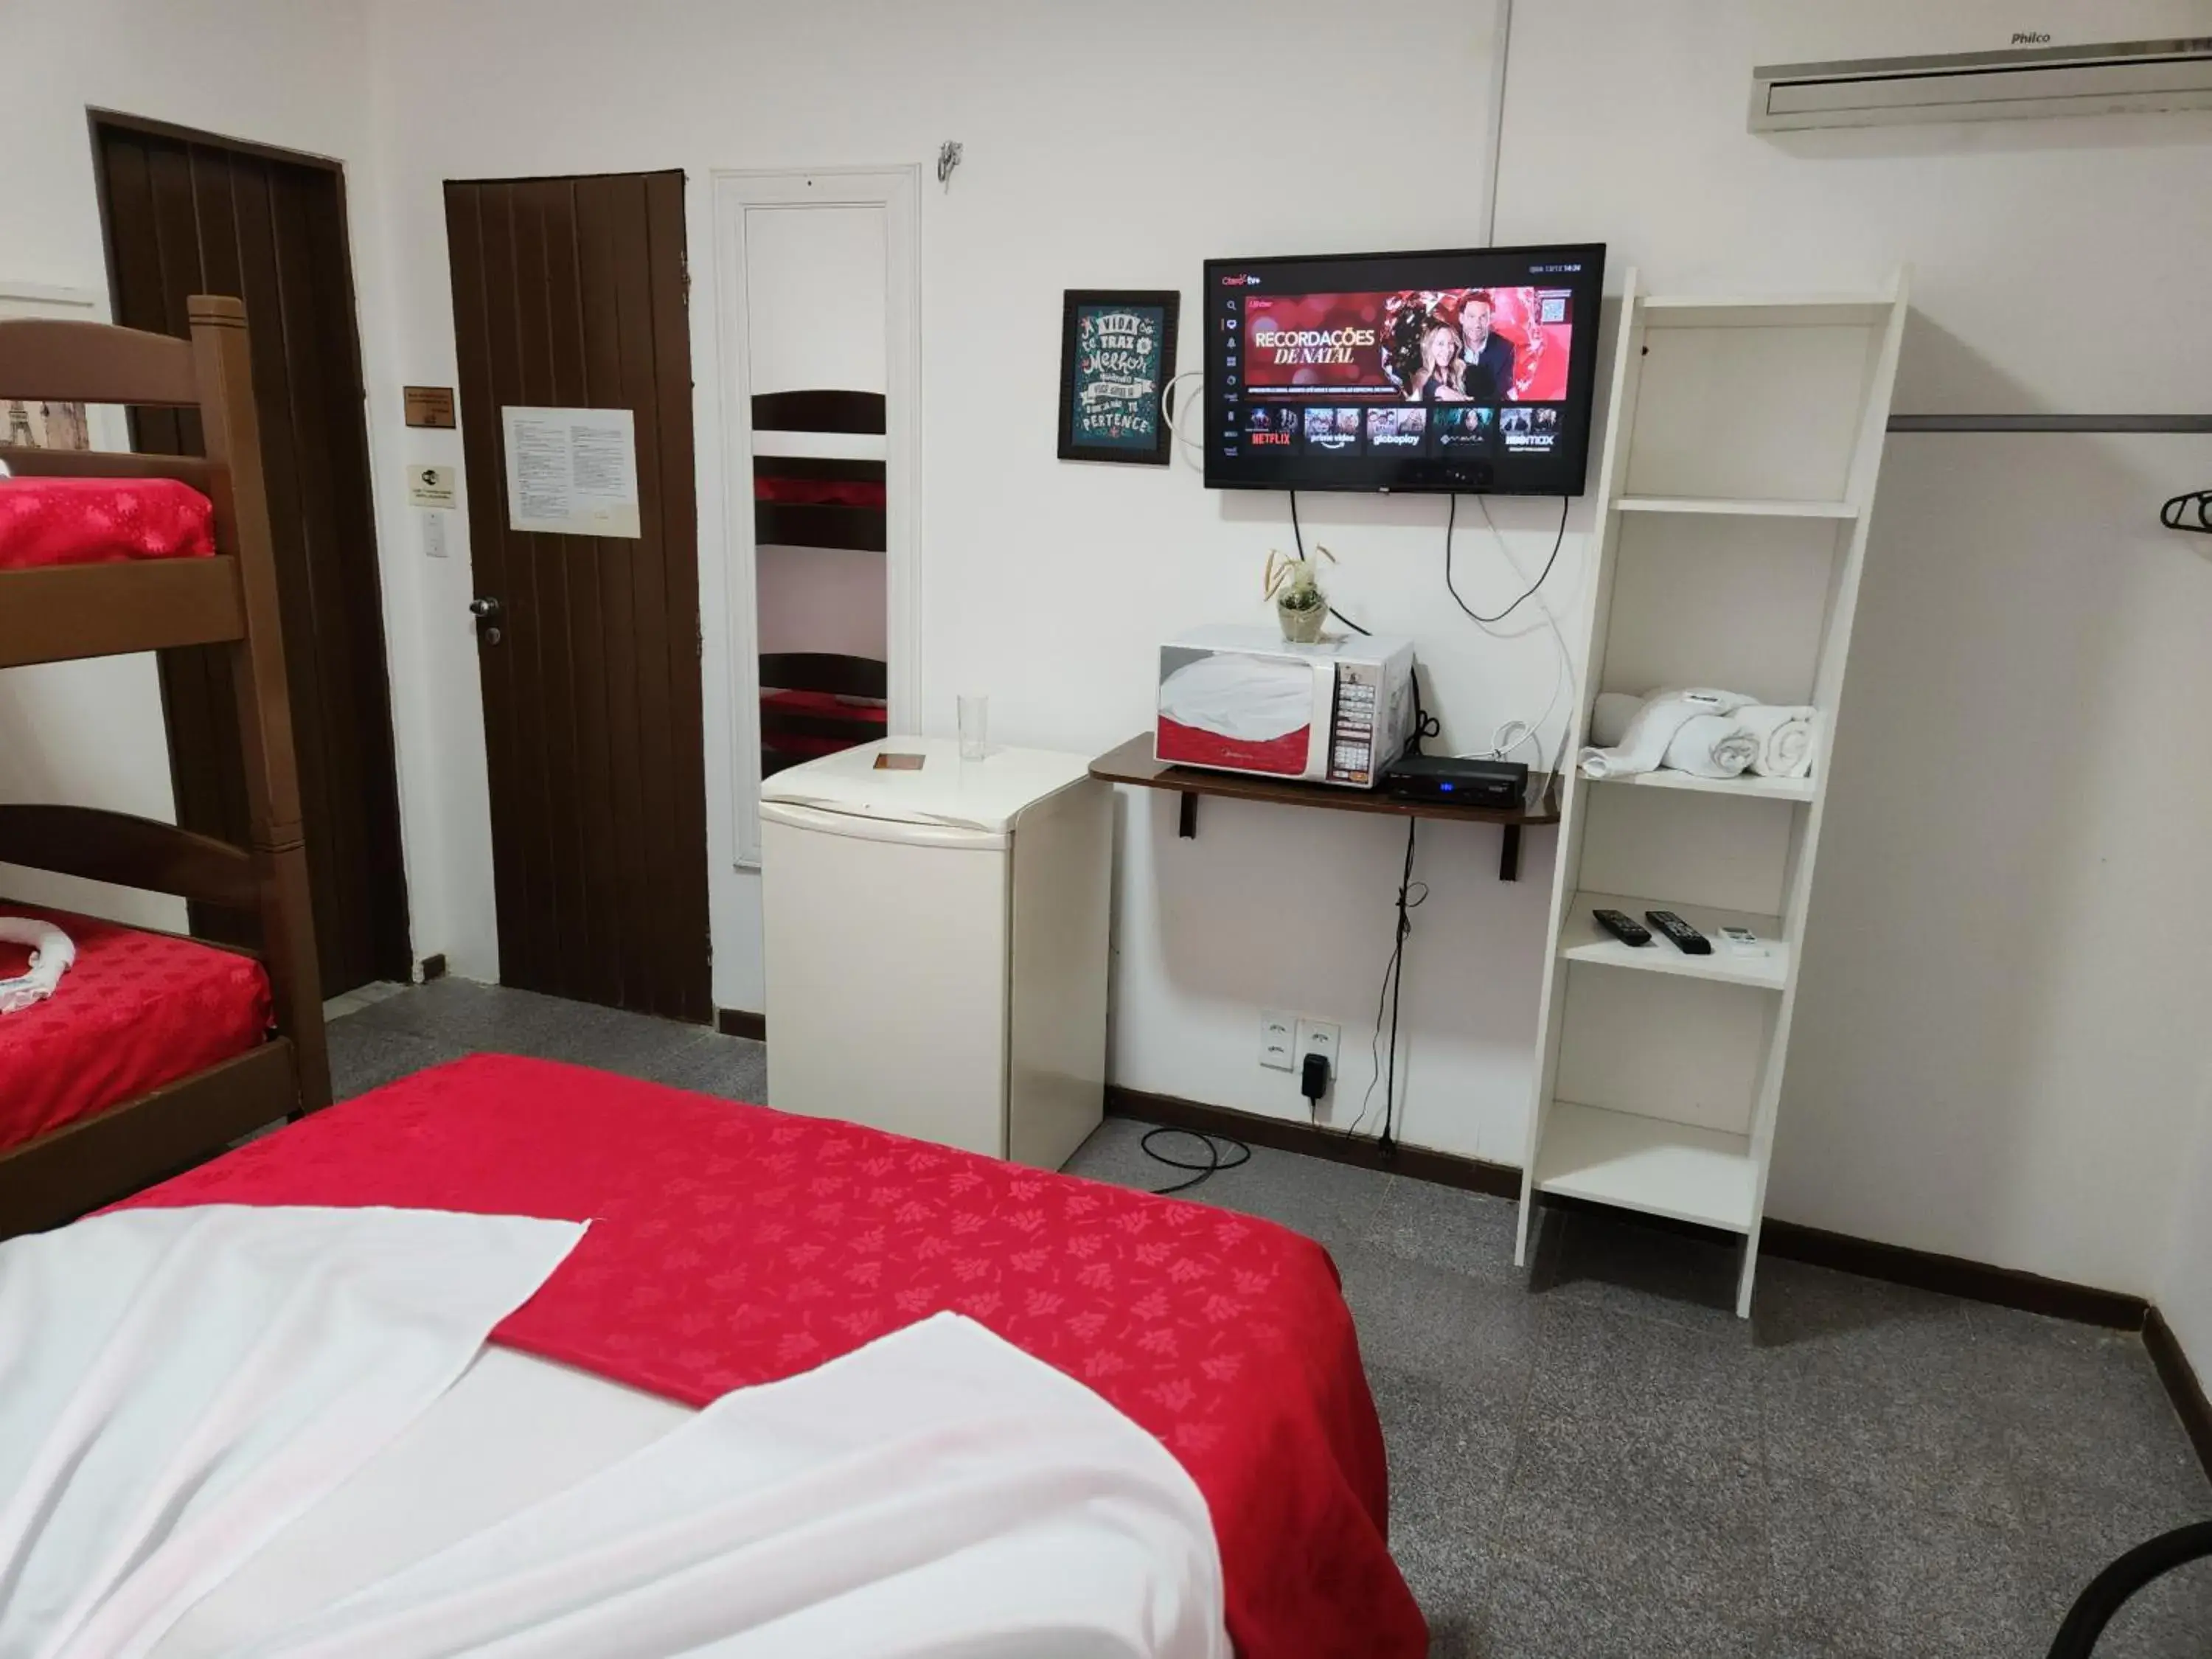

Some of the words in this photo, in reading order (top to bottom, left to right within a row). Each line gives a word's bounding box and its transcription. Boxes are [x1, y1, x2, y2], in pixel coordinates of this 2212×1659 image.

[2011, 32, 2051, 44] Philco
[1103, 316, 1134, 332] VIDA
[1099, 335, 1135, 349] TRAZ
[1256, 327, 1375, 348] RECORDAÇÕES
[1274, 348, 1298, 364] DE
[1300, 347, 1354, 364] NATAL
[1083, 414, 1149, 434] PERTENCE
[1252, 433, 1290, 444] NETFLIX
[1310, 434, 1333, 442] prime
[1334, 434, 1356, 442] video
[1374, 434, 1420, 445] globoplay
